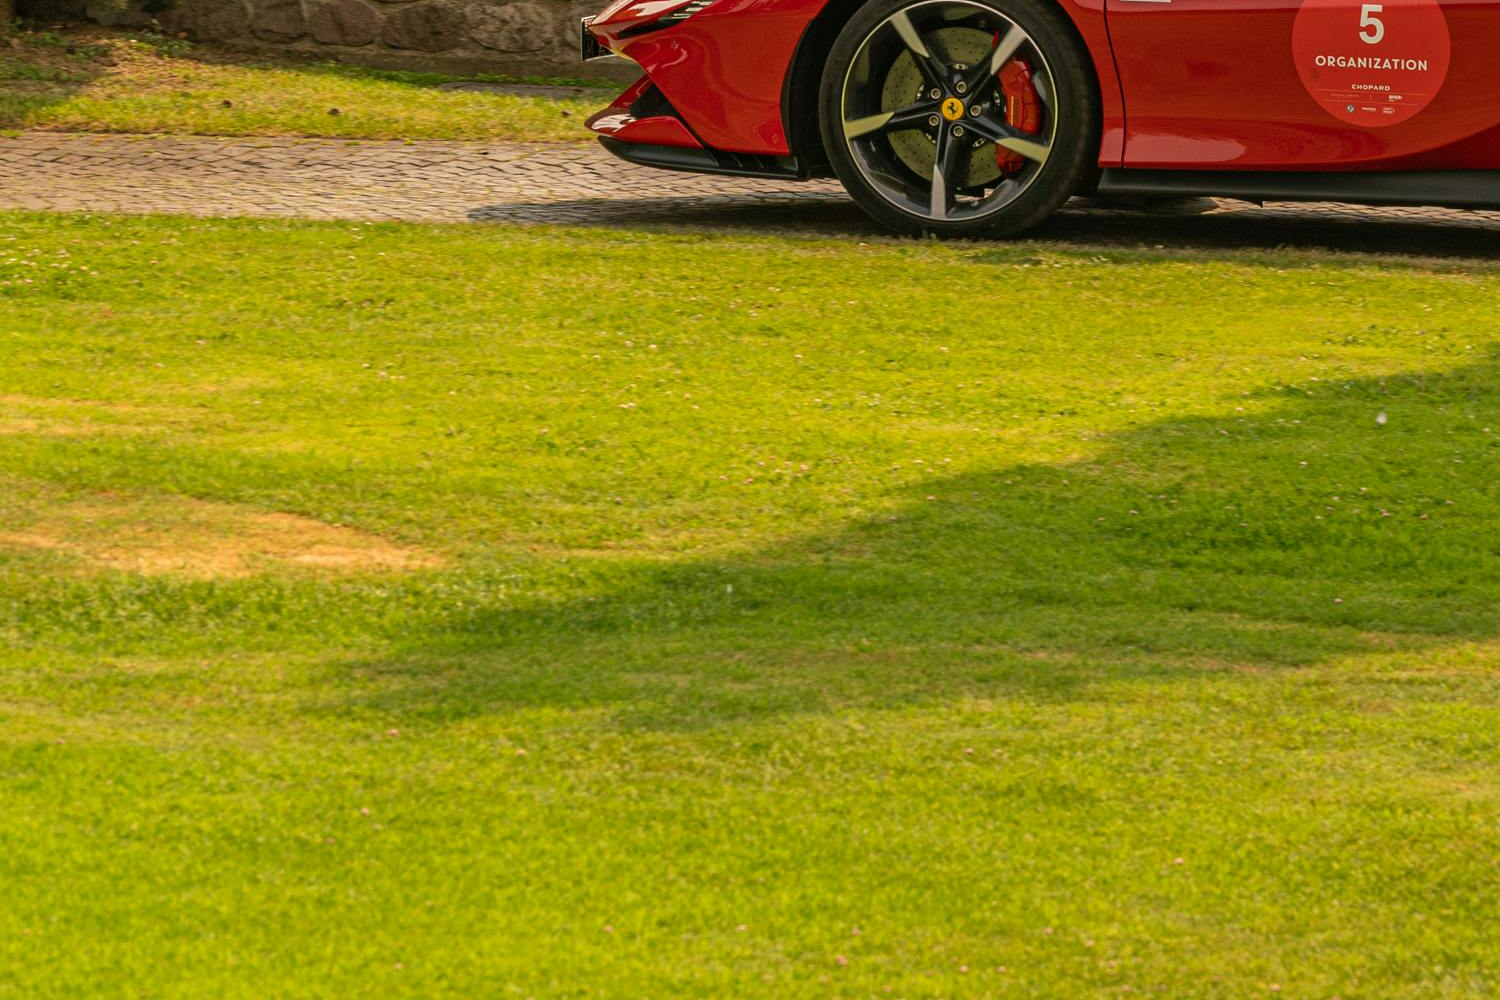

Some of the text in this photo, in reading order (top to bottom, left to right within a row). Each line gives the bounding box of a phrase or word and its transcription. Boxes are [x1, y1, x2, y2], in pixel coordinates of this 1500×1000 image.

[1359, 4, 1384, 44] 5
[1315, 55, 1428, 71] ORGANIZATION
[1351, 83, 1391, 91] CHOPARD
